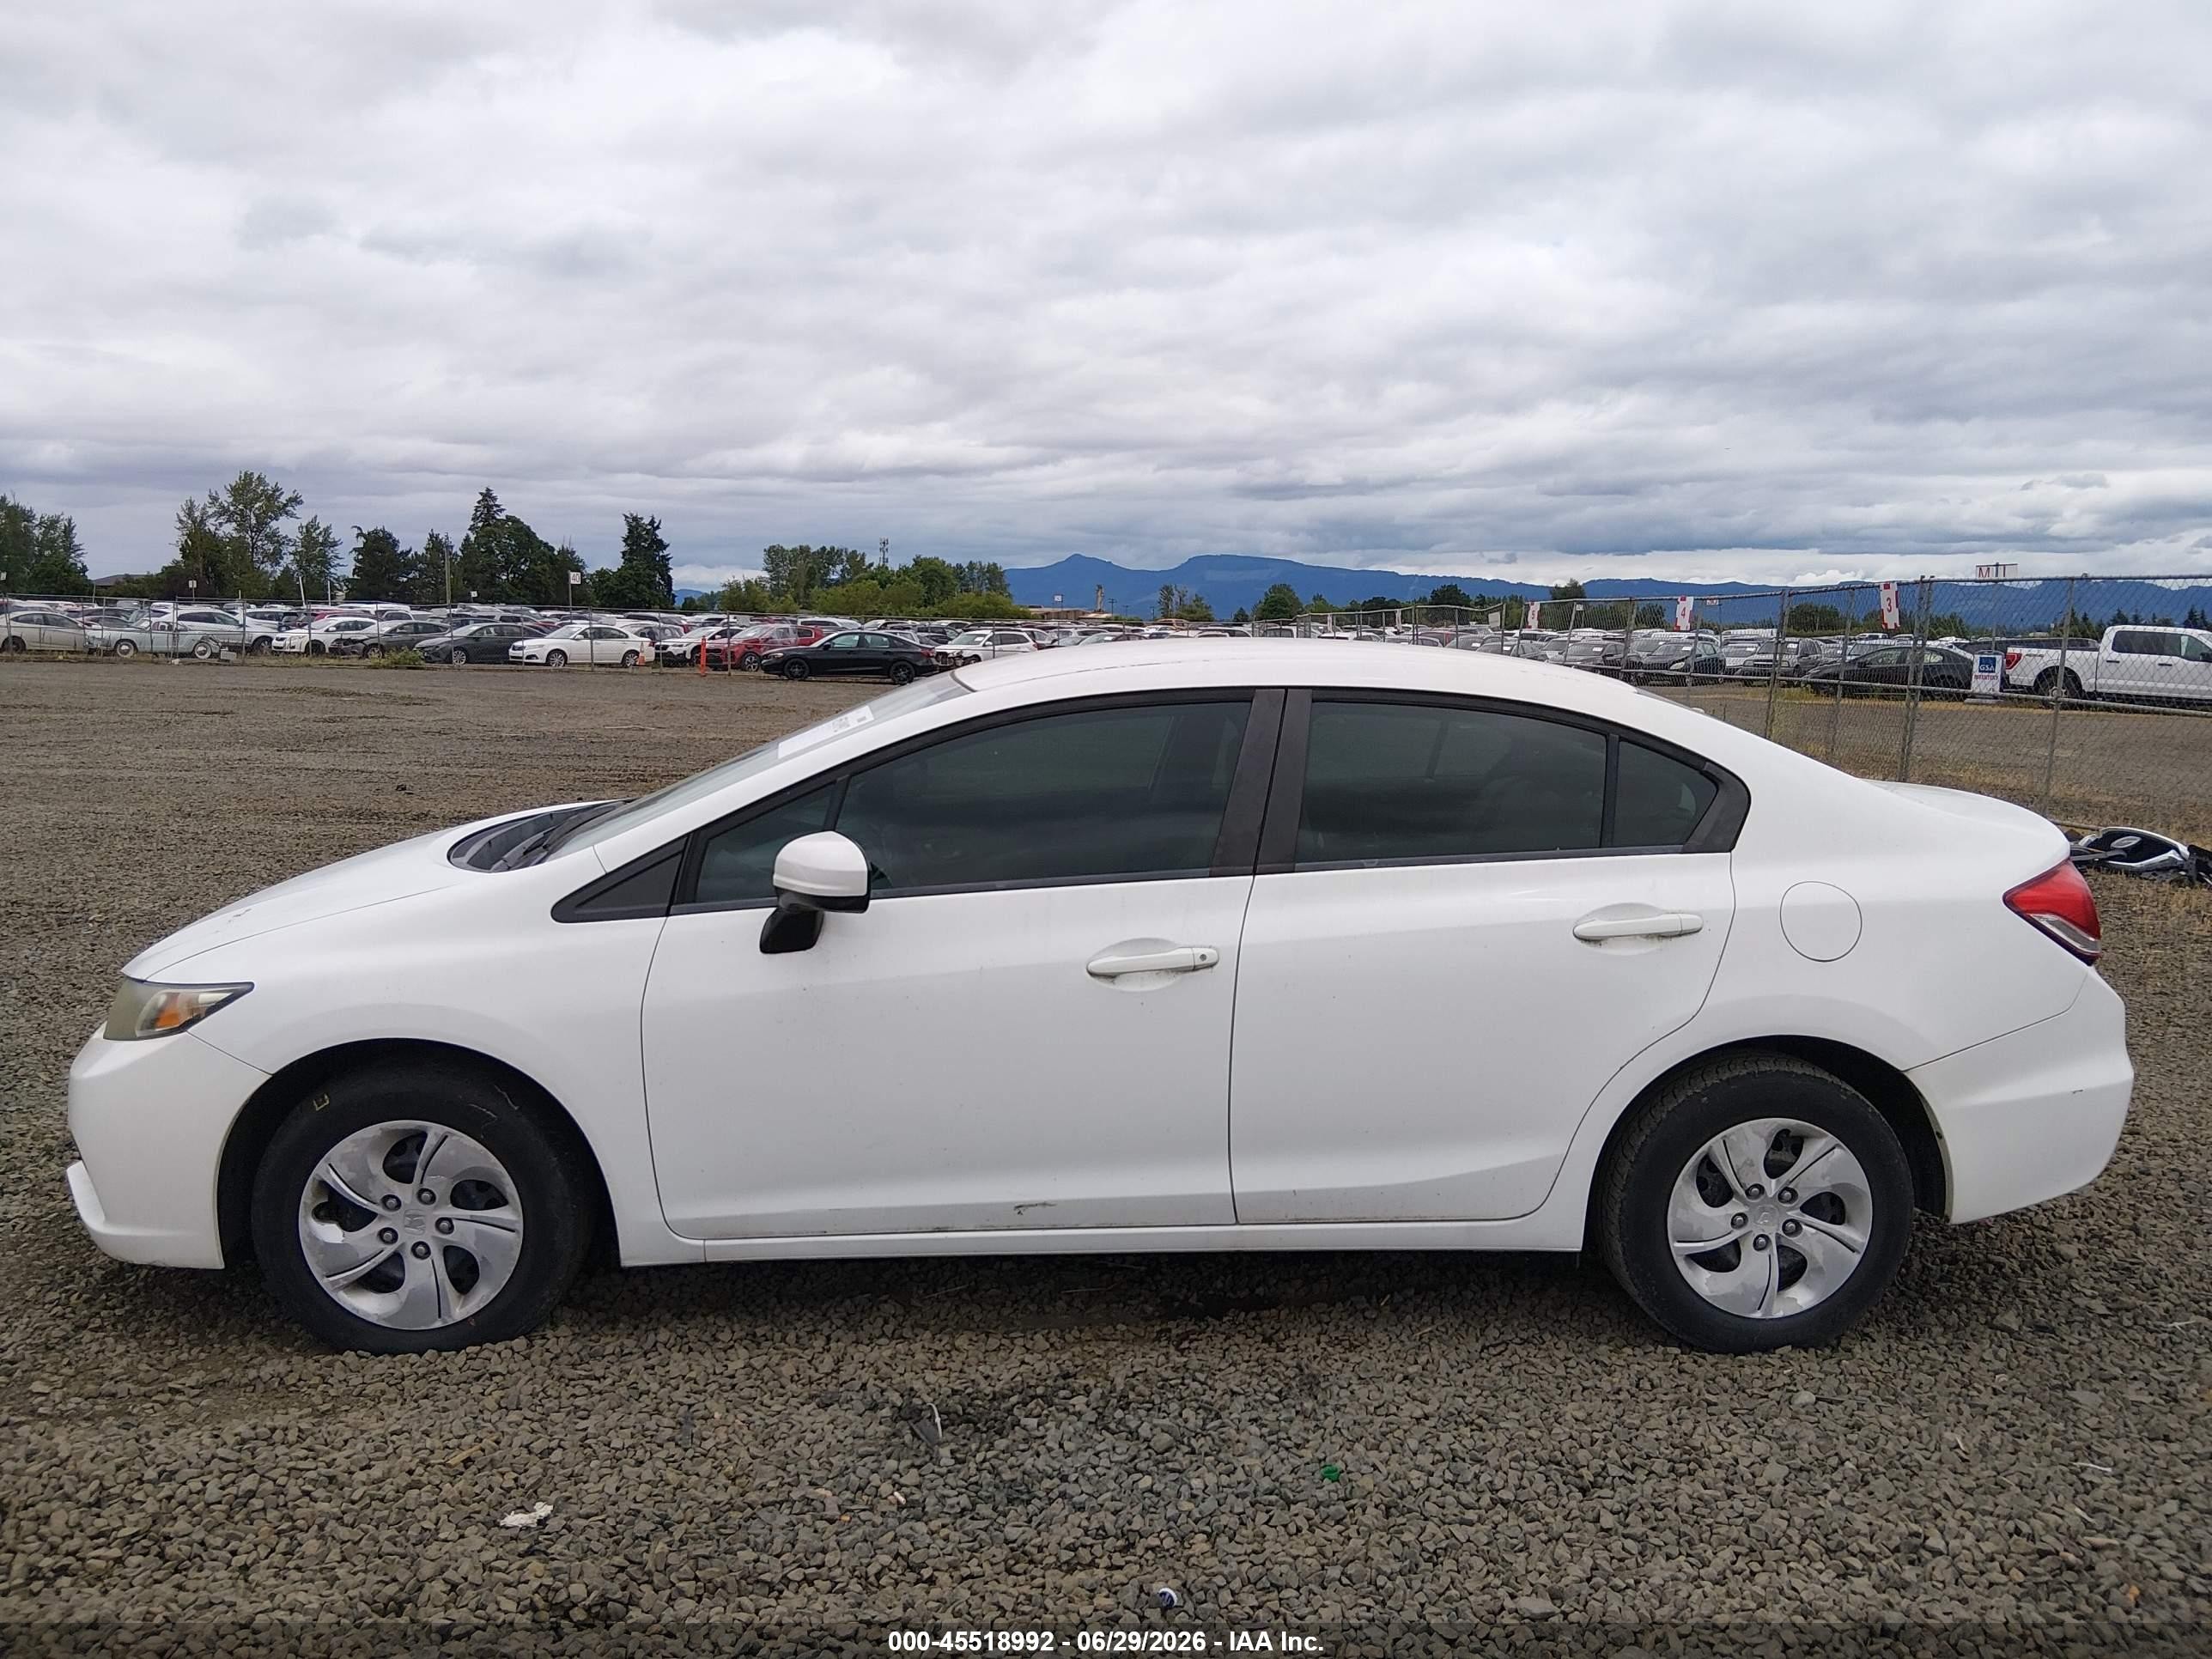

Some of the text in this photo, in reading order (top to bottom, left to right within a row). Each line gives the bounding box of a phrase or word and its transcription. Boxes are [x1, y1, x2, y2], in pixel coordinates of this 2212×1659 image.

[571, 574, 580, 583] 40
[1886, 597, 1893, 613] 3
[1680, 606, 1686, 619] 4
